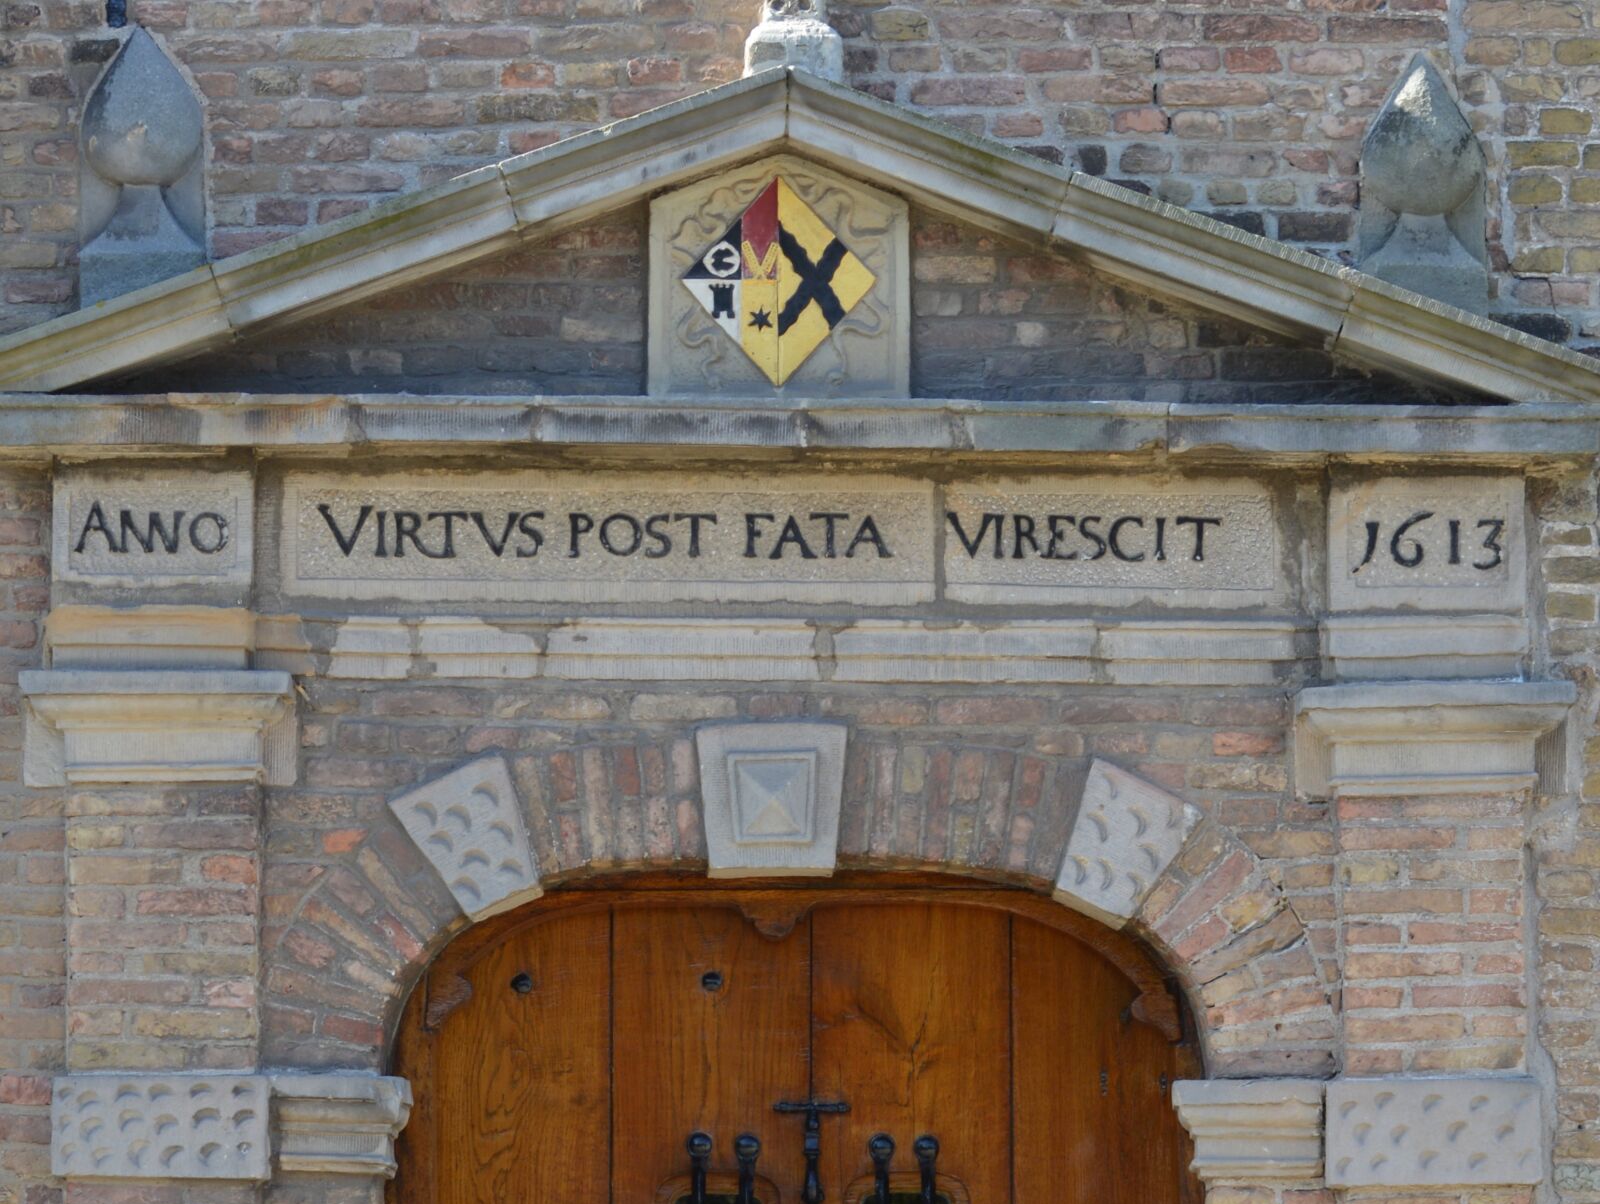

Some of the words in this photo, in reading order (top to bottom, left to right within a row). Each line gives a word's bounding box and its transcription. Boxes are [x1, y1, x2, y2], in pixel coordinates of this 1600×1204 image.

[74, 501, 230, 556] ANNO
[317, 504, 545, 559] VIRTVS
[567, 511, 717, 559] POST
[743, 511, 895, 561] FATA
[945, 511, 1222, 563] VIRESCIT
[1352, 511, 1506, 574] 1613
